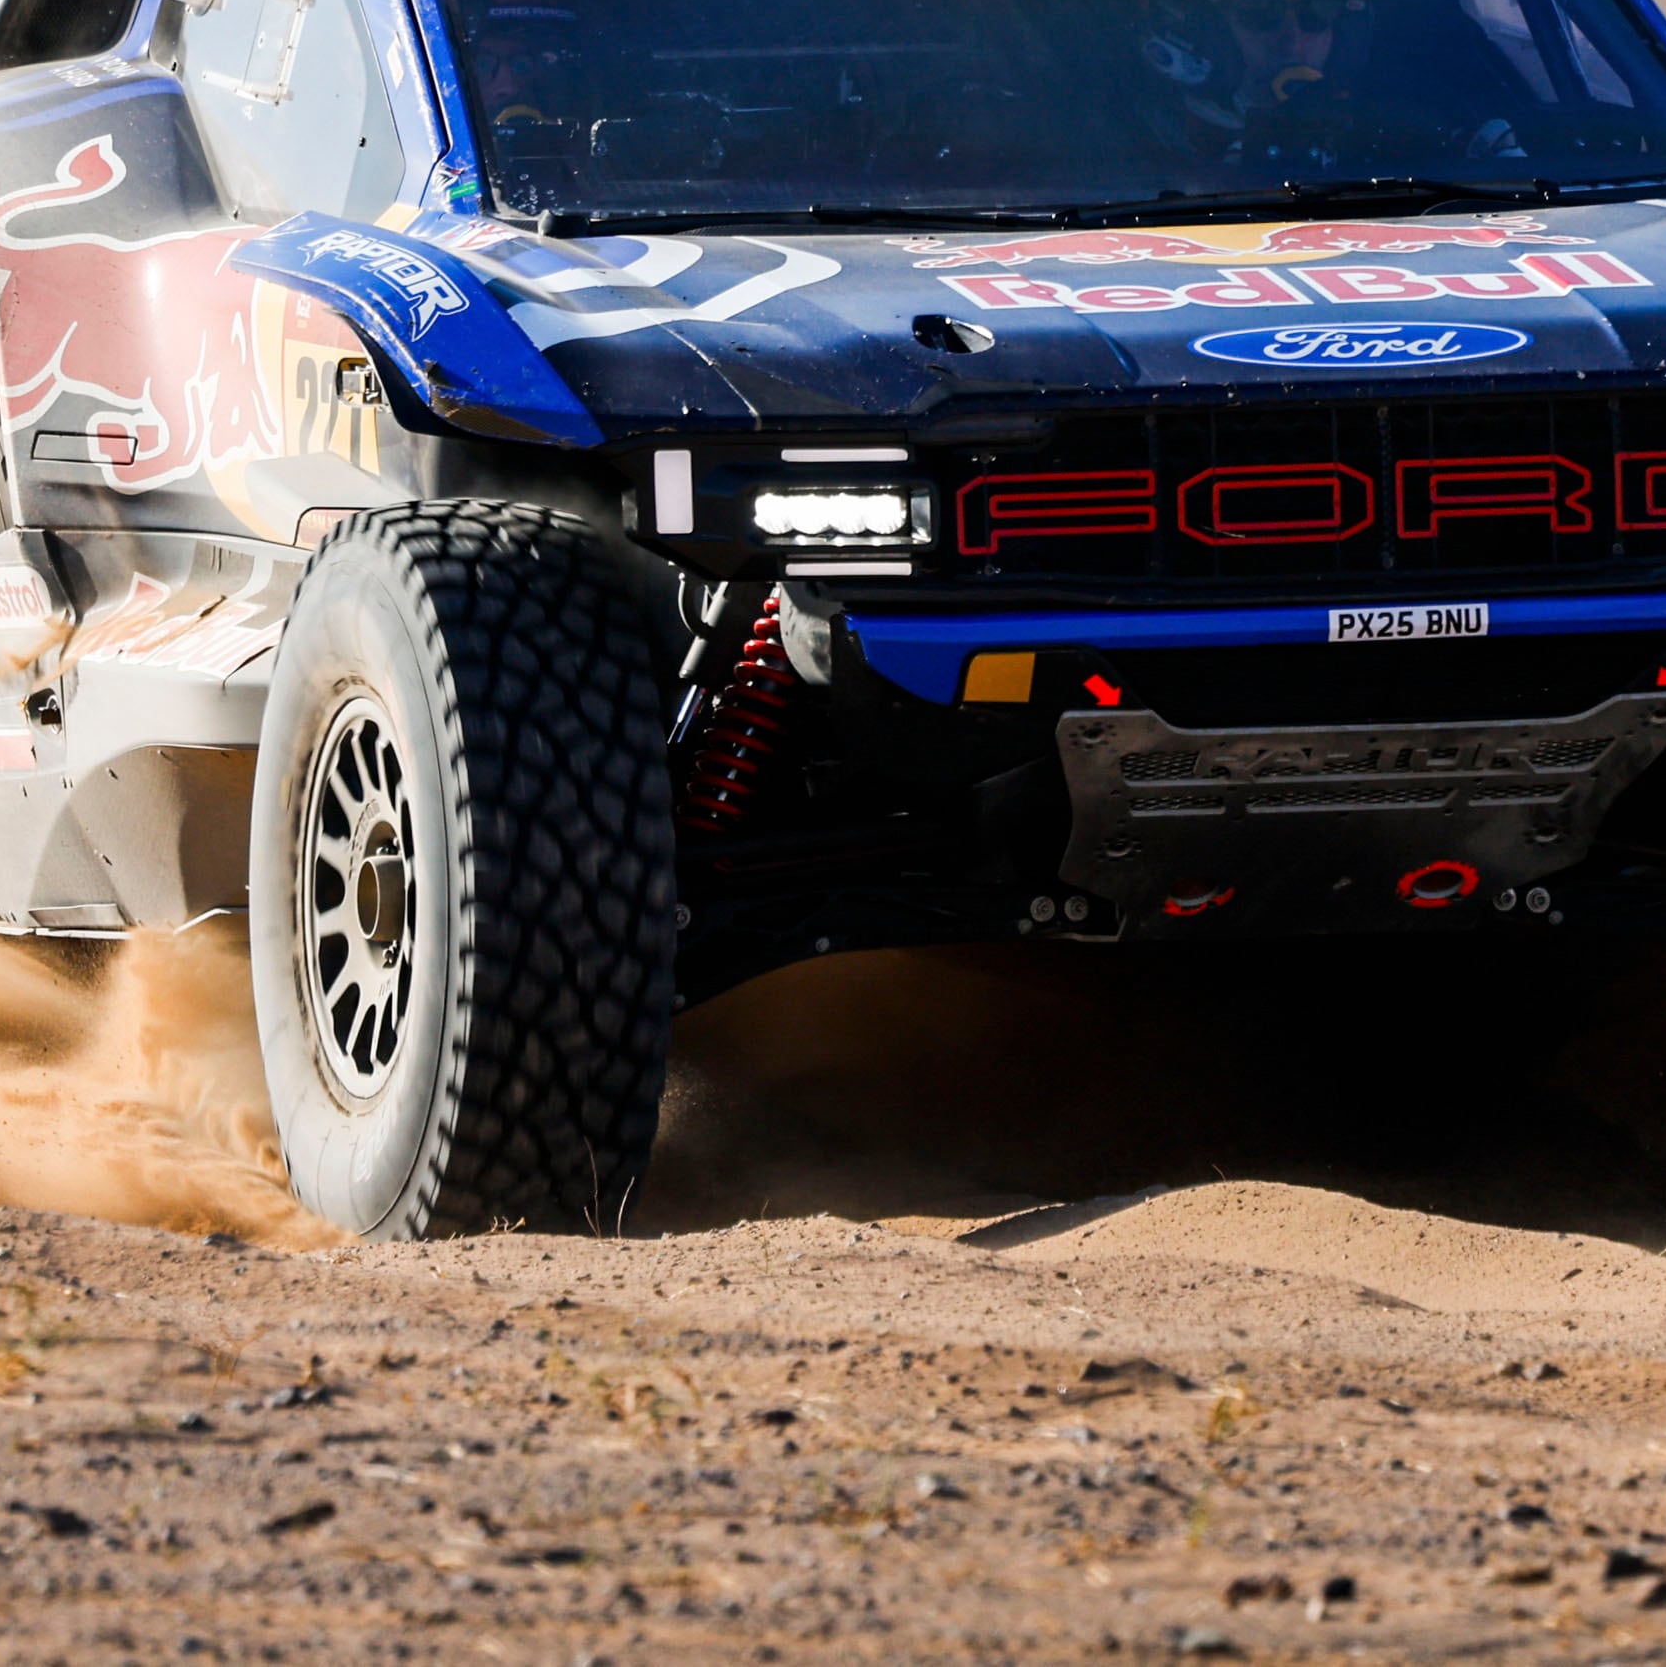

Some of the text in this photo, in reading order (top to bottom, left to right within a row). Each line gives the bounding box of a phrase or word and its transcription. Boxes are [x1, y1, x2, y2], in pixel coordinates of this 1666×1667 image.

[297, 230, 470, 341] RAPTOR
[938, 252, 1654, 314] Red Bull
[1263, 327, 1461, 361] Ford
[1336, 605, 1483, 640] PX25 BNU
